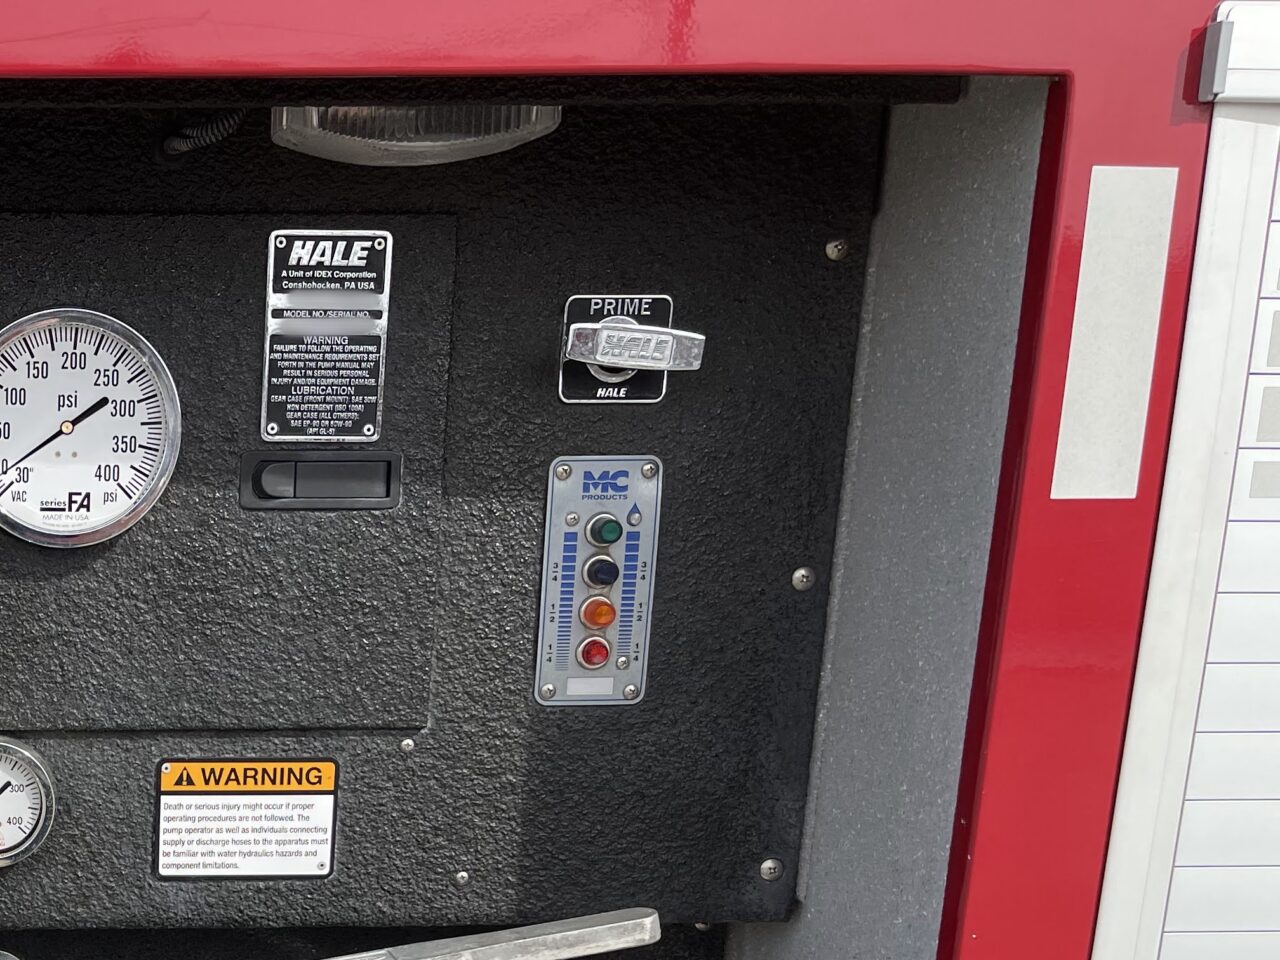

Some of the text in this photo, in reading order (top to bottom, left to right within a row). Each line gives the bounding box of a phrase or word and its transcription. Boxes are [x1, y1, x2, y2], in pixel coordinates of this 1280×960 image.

[288, 240, 373, 267] HALE
[289, 270, 304, 278] Unit
[334, 271, 377, 279] Corporation
[283, 310, 311, 318] MODEL
[590, 299, 653, 316] PRIME
[303, 336, 349, 345] WARNING
[61, 352, 87, 370] 200
[25, 361, 49, 379] 150
[93, 369, 119, 387] 250
[4, 388, 27, 406] 100
[292, 386, 355, 395] LUBRICATION
[596, 388, 628, 397] HALE
[57, 390, 78, 412] psi
[110, 400, 136, 417] 300
[112, 436, 137, 453] 350
[94, 464, 120, 482] 400
[583, 470, 629, 494] MC
[11, 490, 27, 502] VAC
[40, 492, 91, 512] series FA
[103, 490, 118, 505] psi
[201, 767, 323, 786] WARNING
[9, 784, 25, 793] 300
[221, 803, 241, 811] injury
[243, 803, 263, 811] might
[291, 803, 315, 811] proper
[6, 816, 23, 826] 400
[163, 815, 196, 824] operating
[198, 815, 237, 823] procedures
[264, 814, 294, 822] followed.
[297, 814, 310, 822] The
[185, 827, 213, 835] operator
[251, 826, 288, 834] individuals
[289, 827, 328, 835] connecting
[163, 838, 185, 847] supply
[196, 838, 229, 847] discharge
[231, 838, 252, 846] hoses
[274, 838, 309, 846] apparatus
[238, 850, 274, 858] hydraulics
[161, 861, 240, 870] component limitations.
